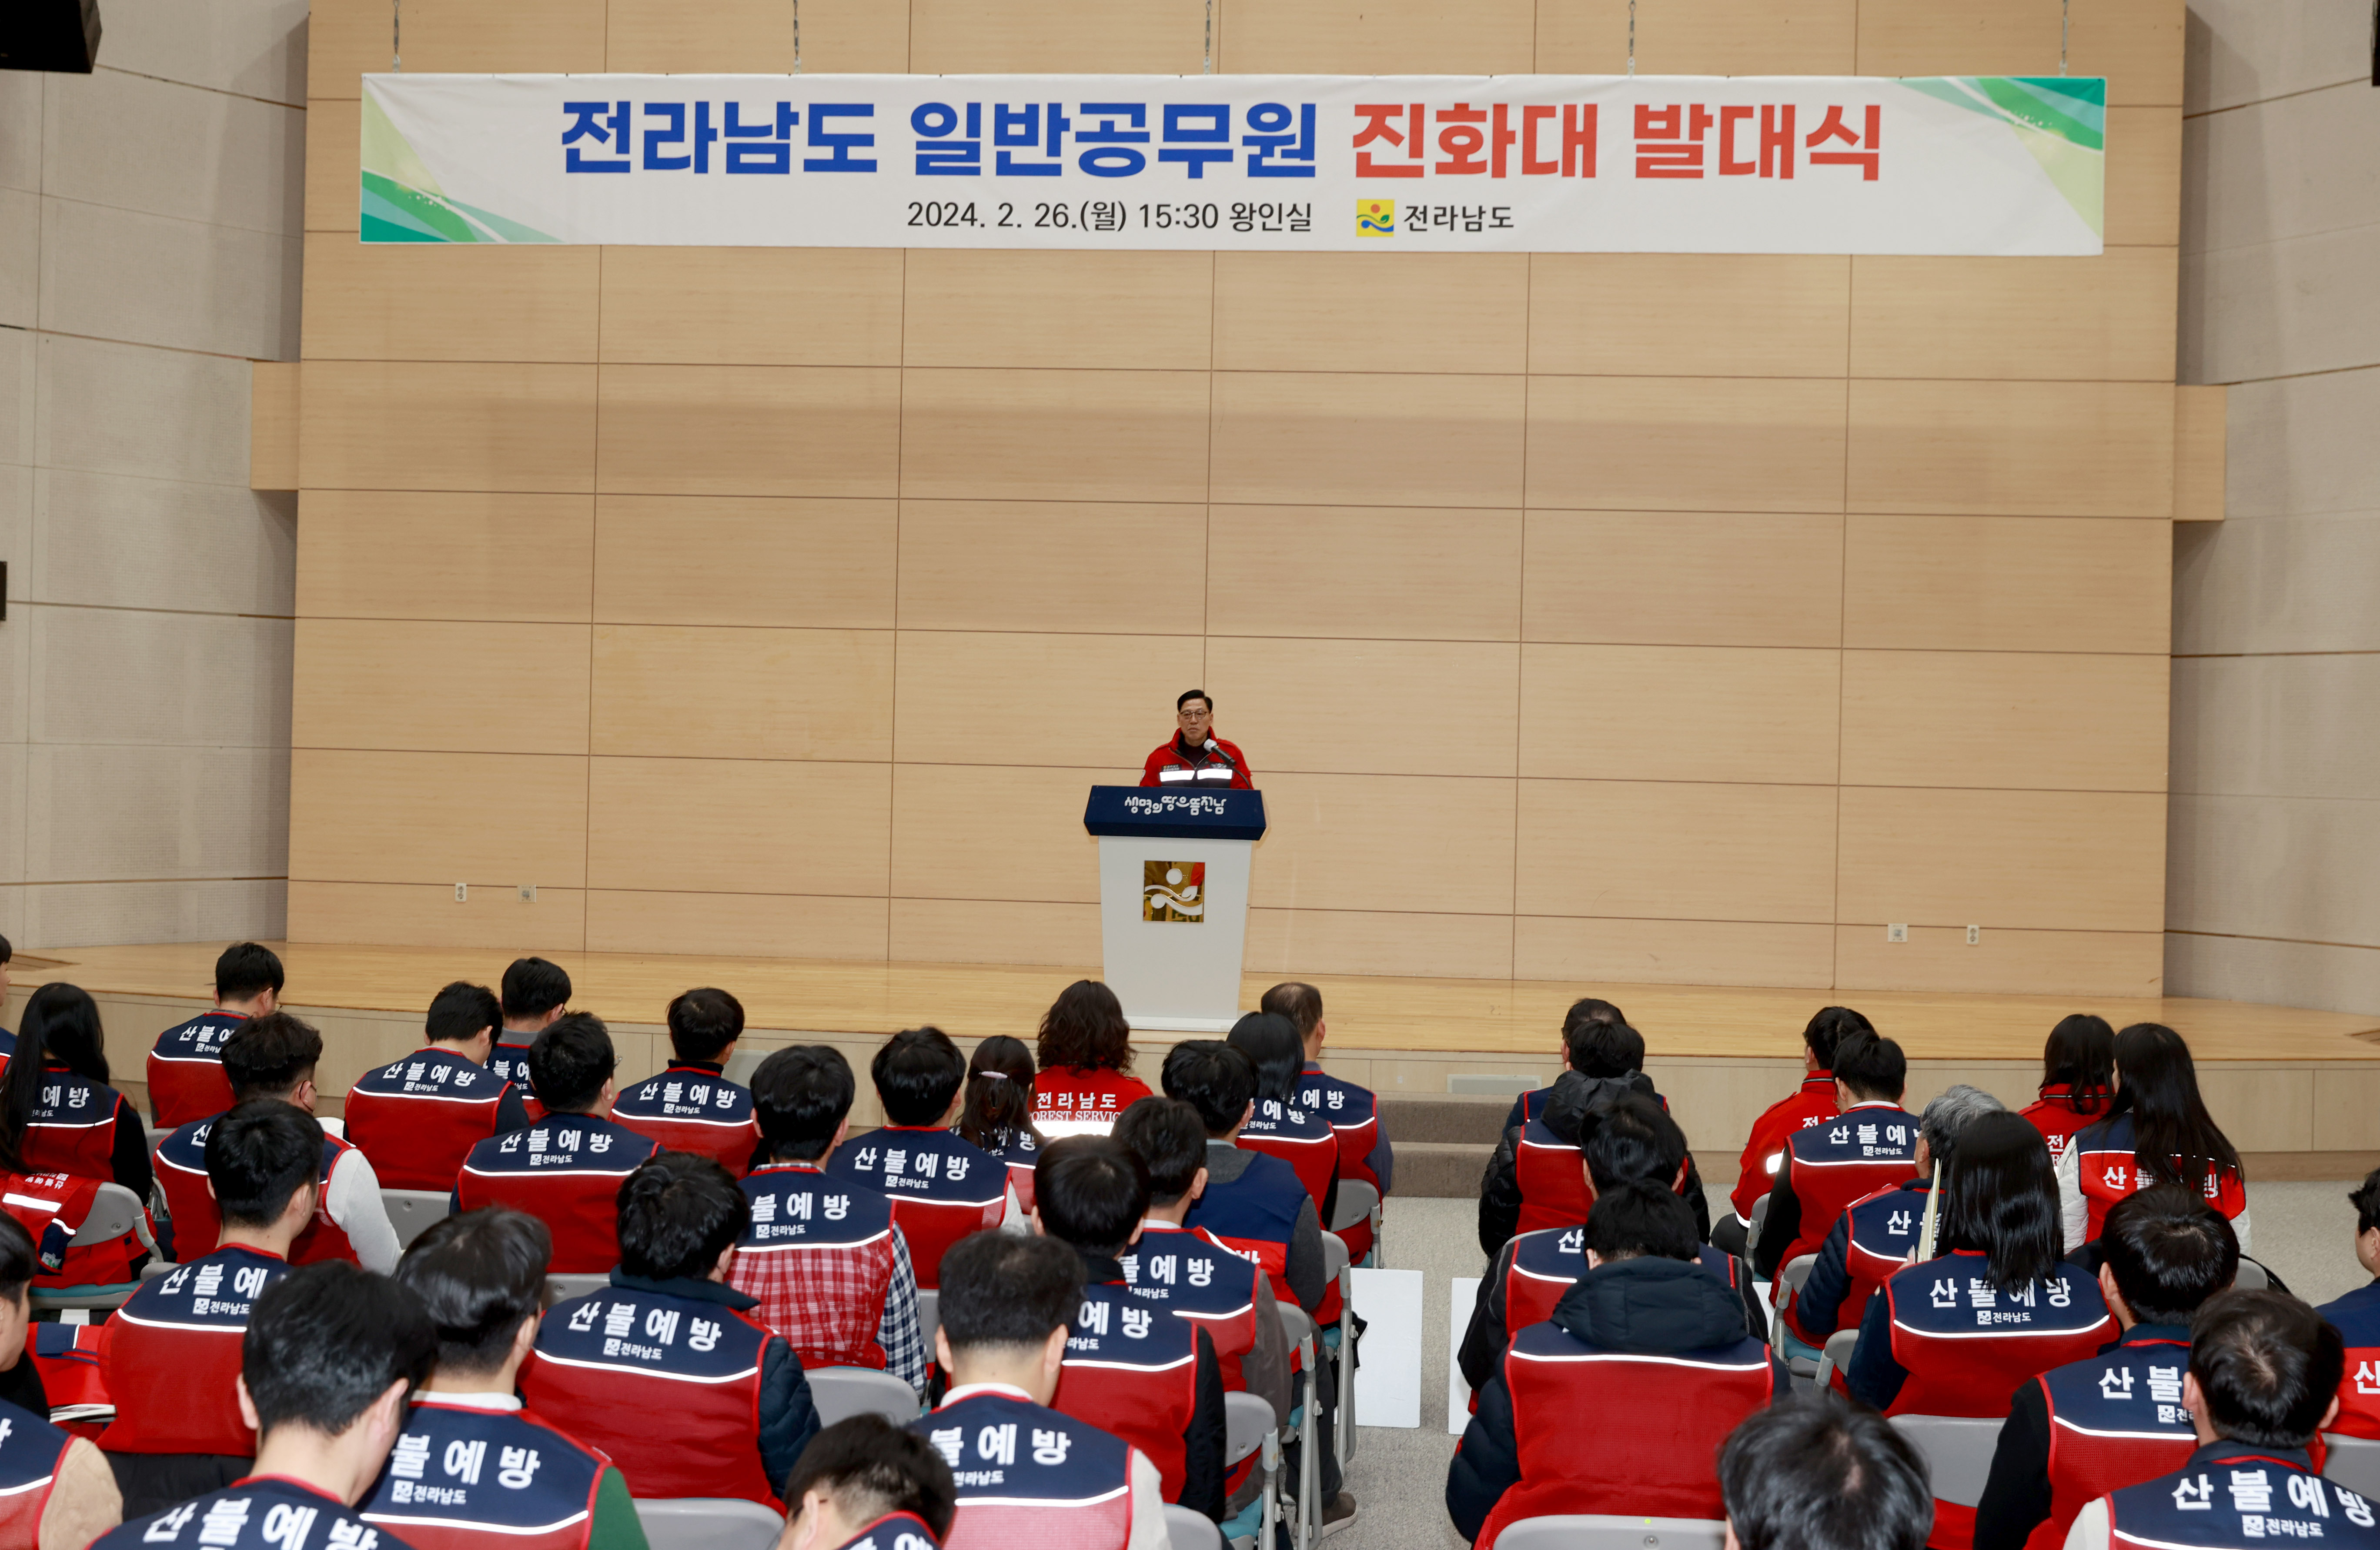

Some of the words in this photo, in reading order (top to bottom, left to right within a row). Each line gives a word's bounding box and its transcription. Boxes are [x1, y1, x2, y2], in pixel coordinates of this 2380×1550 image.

[561, 100, 877, 174] 전라남도
[909, 102, 1316, 179] 일반공무원
[1352, 103, 1598, 179] 진화대
[1633, 104, 1881, 181] 발대식
[907, 201, 986, 227] 2024.
[997, 203, 1022, 228] 2.
[1034, 201, 1127, 231] 26.(월)
[1139, 203, 1219, 228] 15:30
[1229, 203, 1312, 232] 왕인실
[1404, 204, 1514, 231] 전라남도
[204, 1045, 221, 1053] 전라남
[414, 1083, 439, 1092] 전라남도
[1037, 1092, 1116, 1109] 전라남도
[674, 1105, 700, 1114] 전라남도
[1029, 1110, 1072, 1122] OREST
[1075, 1111, 1121, 1122] SERVIC
[1249, 1121, 1277, 1130] 전라남도
[1828, 1124, 1919, 1146] 산불예
[1874, 1147, 1903, 1155] 전라남도
[542, 1155, 572, 1164] 전라남도
[898, 1177, 929, 1189] 전라남도
[770, 1224, 806, 1236] 전라남도
[159, 1264, 268, 1299] 산불예
[210, 1301, 250, 1315] 전라남도
[1993, 1312, 2032, 1323] 전라남도
[621, 1342, 662, 1360] 전라남도
[1066, 1337, 1100, 1351] 라남도
[413, 1486, 466, 1505] 전라남도
[2266, 1517, 2324, 1537] 전라남도
